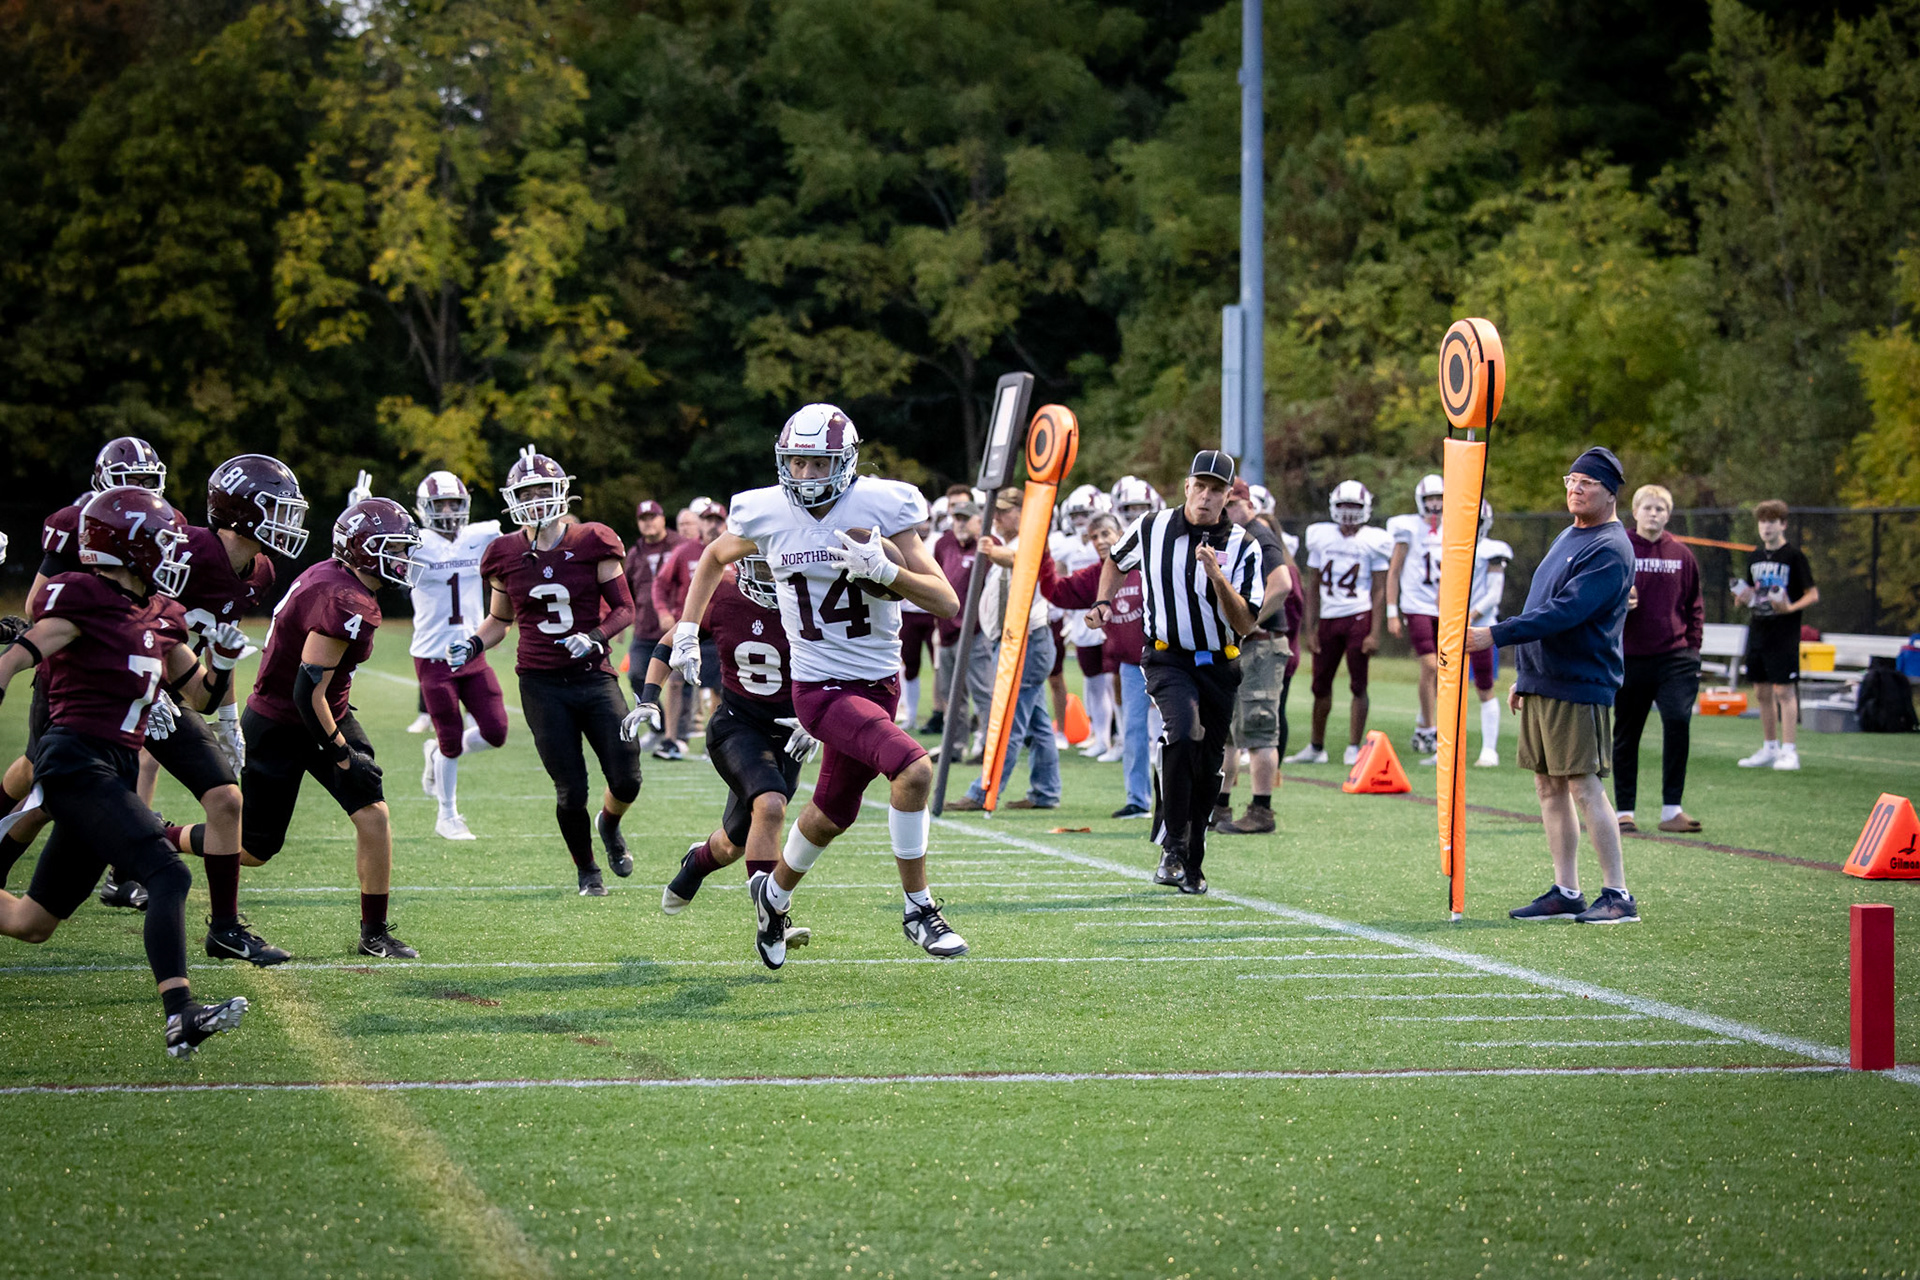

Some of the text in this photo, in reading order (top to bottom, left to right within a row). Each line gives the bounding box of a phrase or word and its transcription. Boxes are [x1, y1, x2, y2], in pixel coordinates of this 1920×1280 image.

[220, 466, 248, 496] 81
[43, 525, 70, 553] 77
[125, 511, 146, 540] 7
[346, 513, 366, 538] 4
[44, 583, 66, 611] 7
[1320, 560, 1360, 598] 44
[446, 572, 464, 626] 1
[528, 583, 574, 634] 3
[787, 568, 871, 642] 14
[343, 613, 363, 640] 4
[734, 641, 782, 696] 8
[120, 655, 162, 733] 7
[1853, 803, 1895, 867] 10
